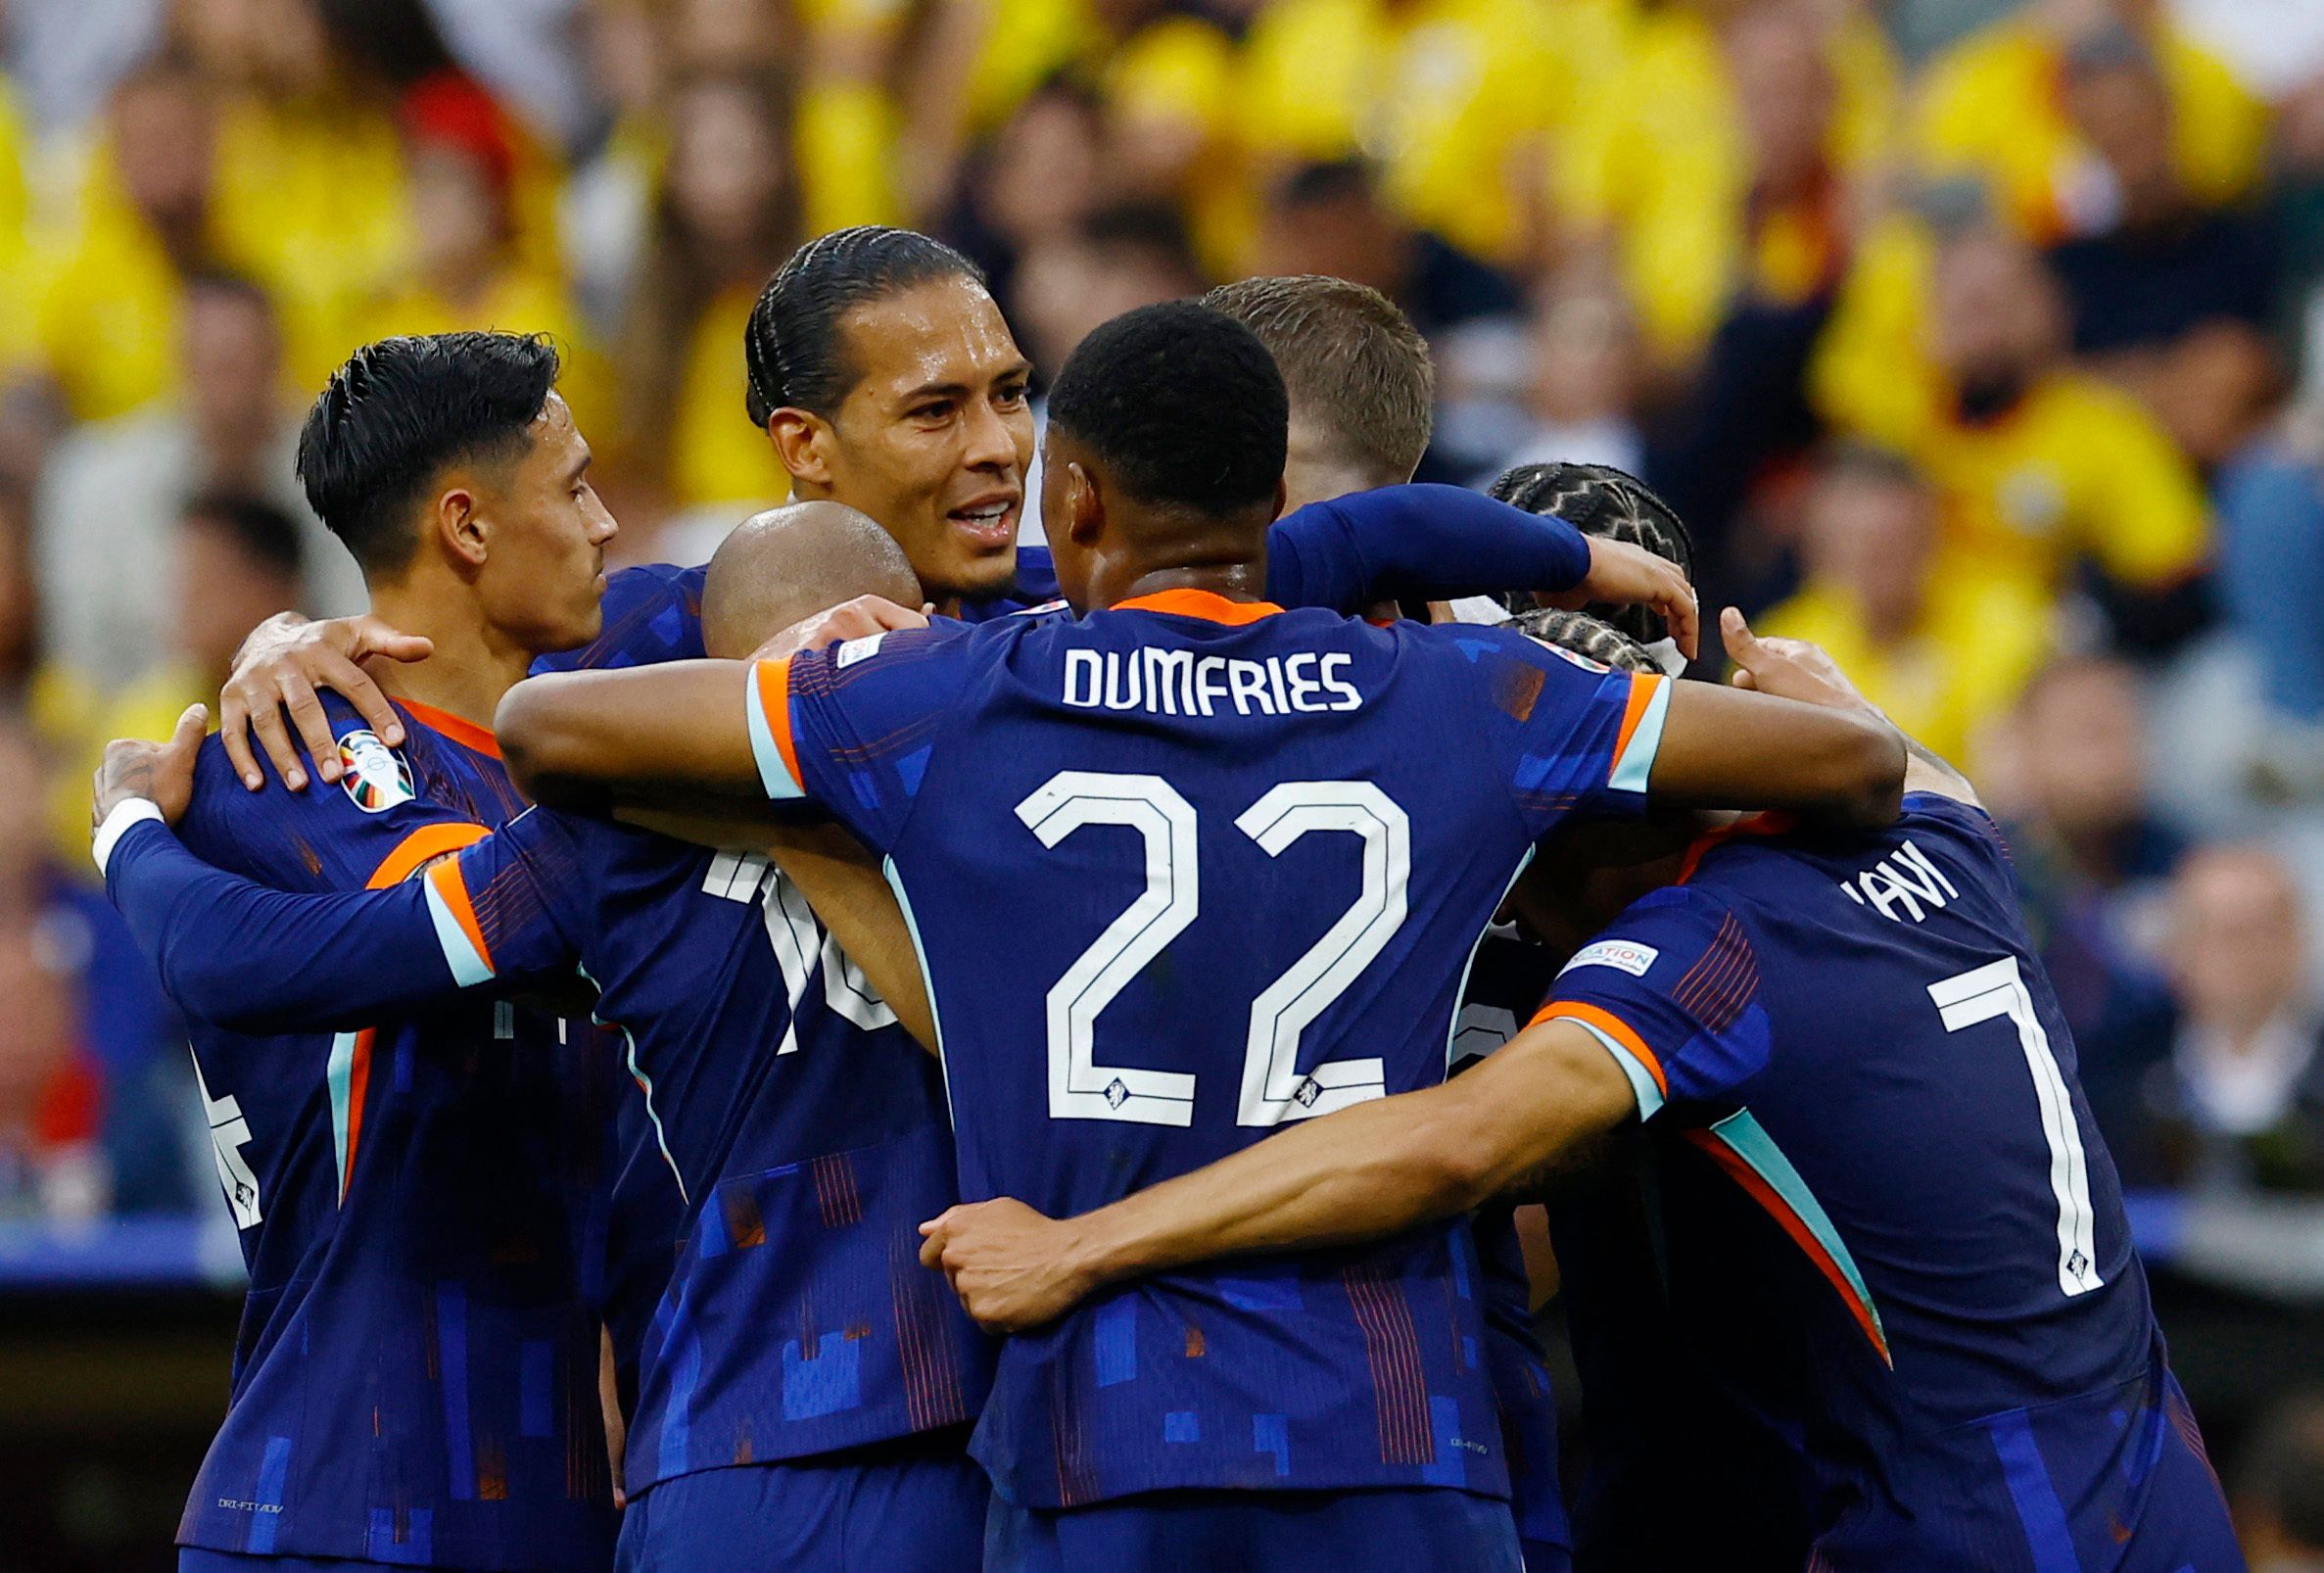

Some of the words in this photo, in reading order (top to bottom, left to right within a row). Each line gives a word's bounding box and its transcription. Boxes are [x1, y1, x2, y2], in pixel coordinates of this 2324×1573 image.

[1063, 646, 1363, 716] DUMFRIES
[1014, 770, 1410, 1126] 22
[1926, 955, 2105, 1297] 7
